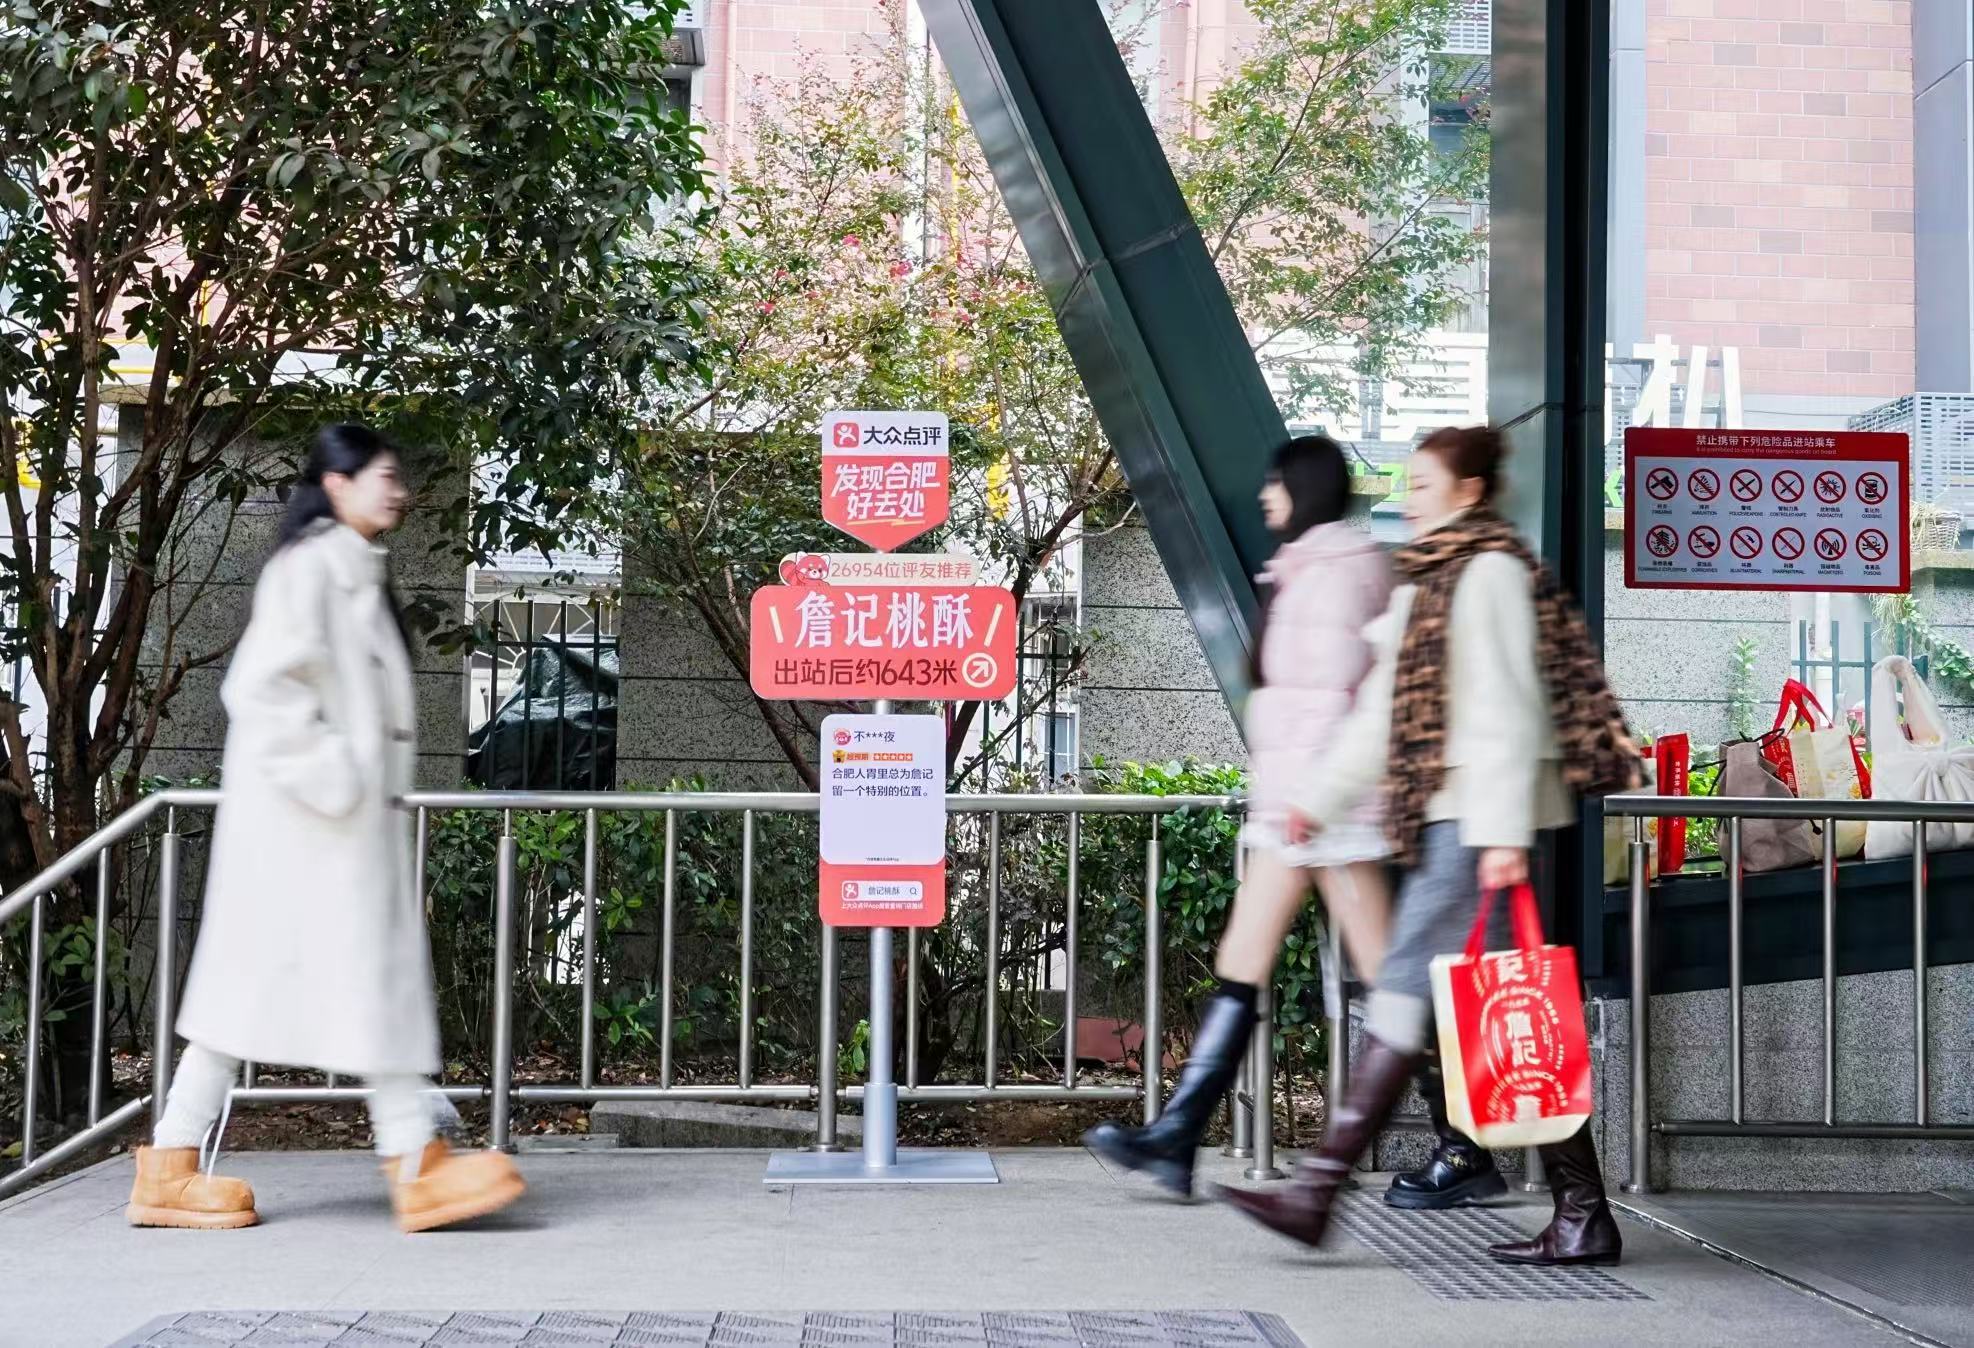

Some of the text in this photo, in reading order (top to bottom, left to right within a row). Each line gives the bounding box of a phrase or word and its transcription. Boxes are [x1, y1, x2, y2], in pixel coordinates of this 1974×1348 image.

[863, 426, 941, 446] 大众点评
[1696, 435, 1836, 448] 禁止携带下列危险品进站乘车
[831, 462, 940, 497] 发现合肥
[847, 490, 924, 520] 好去处
[831, 561, 972, 579] 26954位评友推荐
[795, 592, 974, 649] 詹记桃酥
[774, 657, 957, 686] 出站后约643米
[832, 768, 934, 780] 合肥人胃里总为詹记
[832, 785, 930, 797] 留一个特别的位置。
